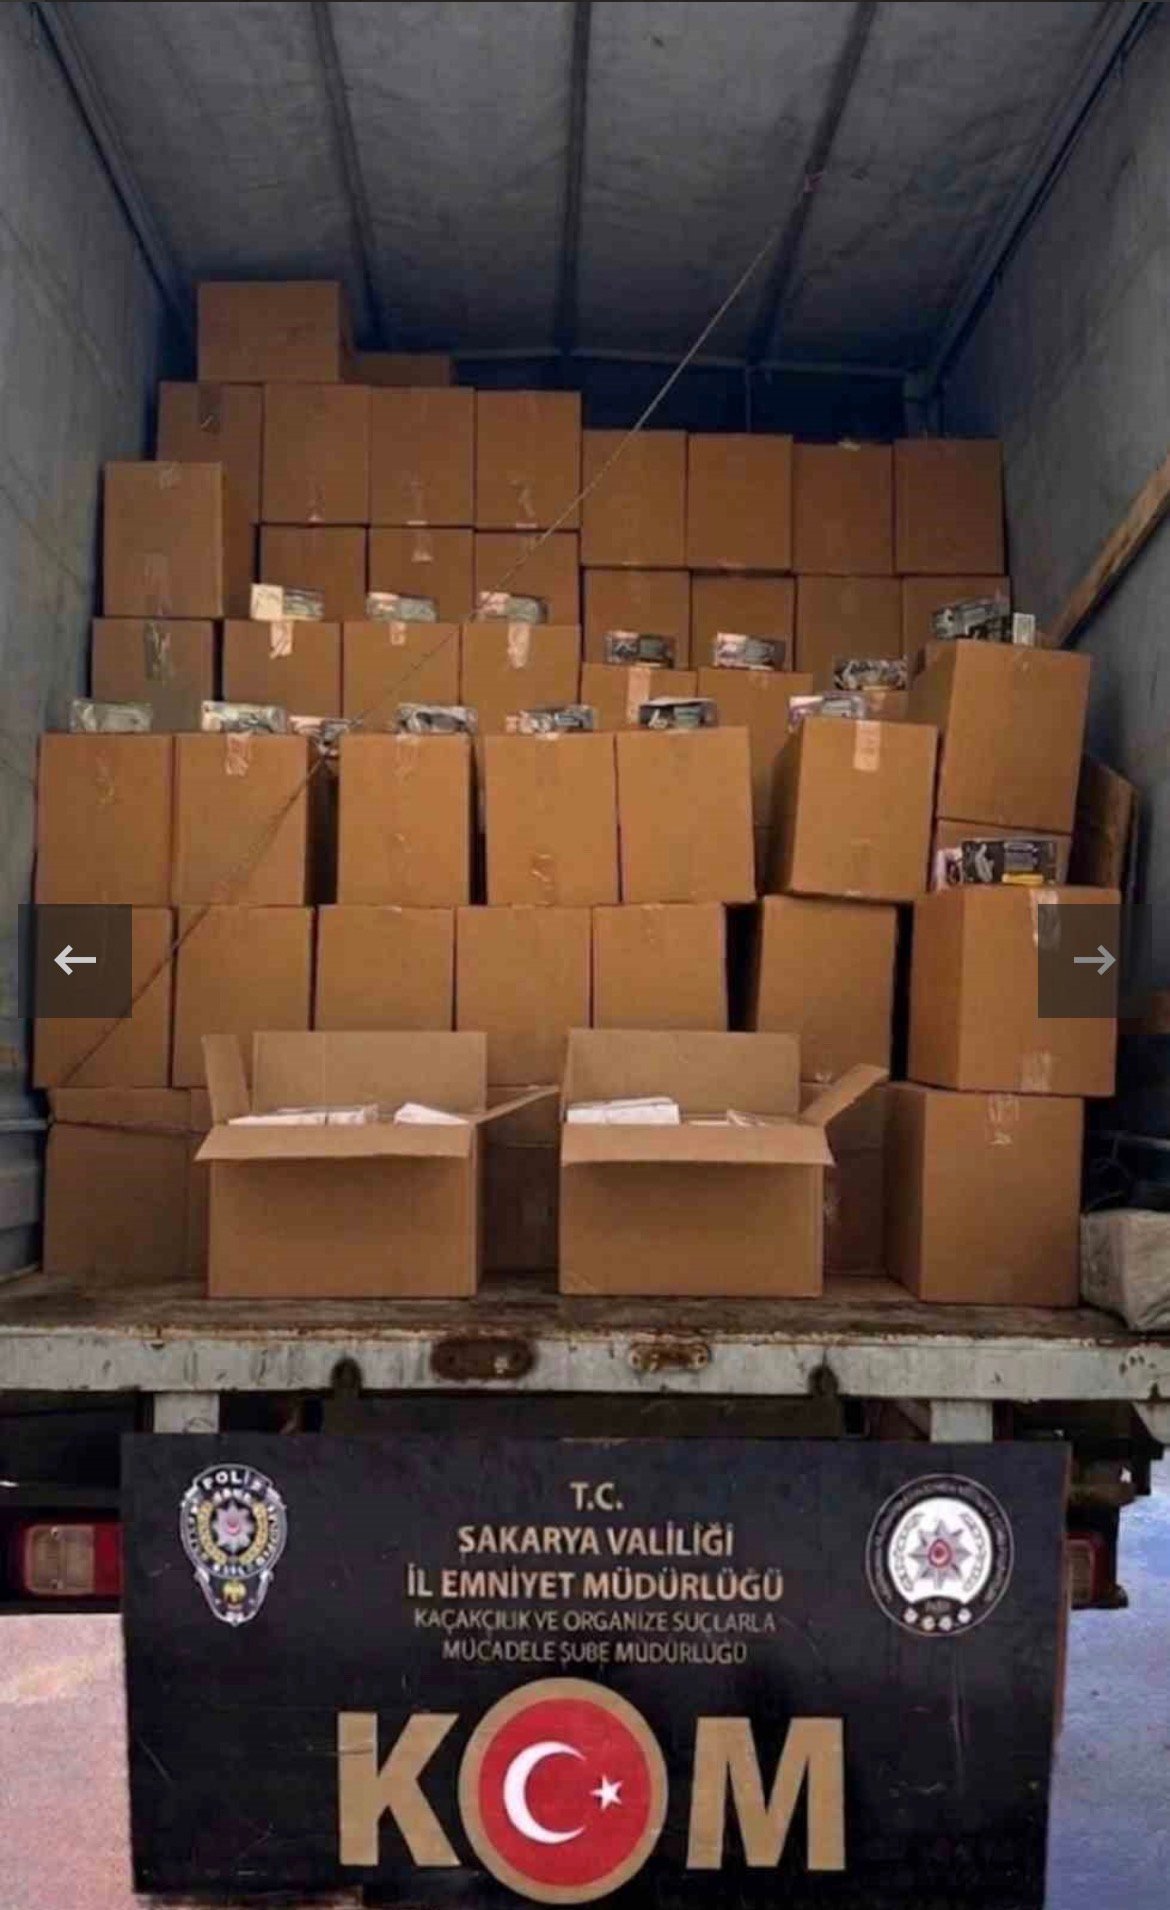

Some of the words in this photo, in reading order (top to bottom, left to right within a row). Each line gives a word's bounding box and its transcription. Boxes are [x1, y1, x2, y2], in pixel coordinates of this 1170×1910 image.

[570, 1482, 624, 1511] T.C.
[606, 1520, 735, 1557] VALİLİĞİ
[407, 1563, 434, 1598] İL
[440, 1565, 576, 1600] EMNİYET
[582, 1566, 785, 1602] MÜDÜRLÜĞÜ
[532, 1610, 559, 1632] VE
[672, 1611, 777, 1640] SUÇLARLA
